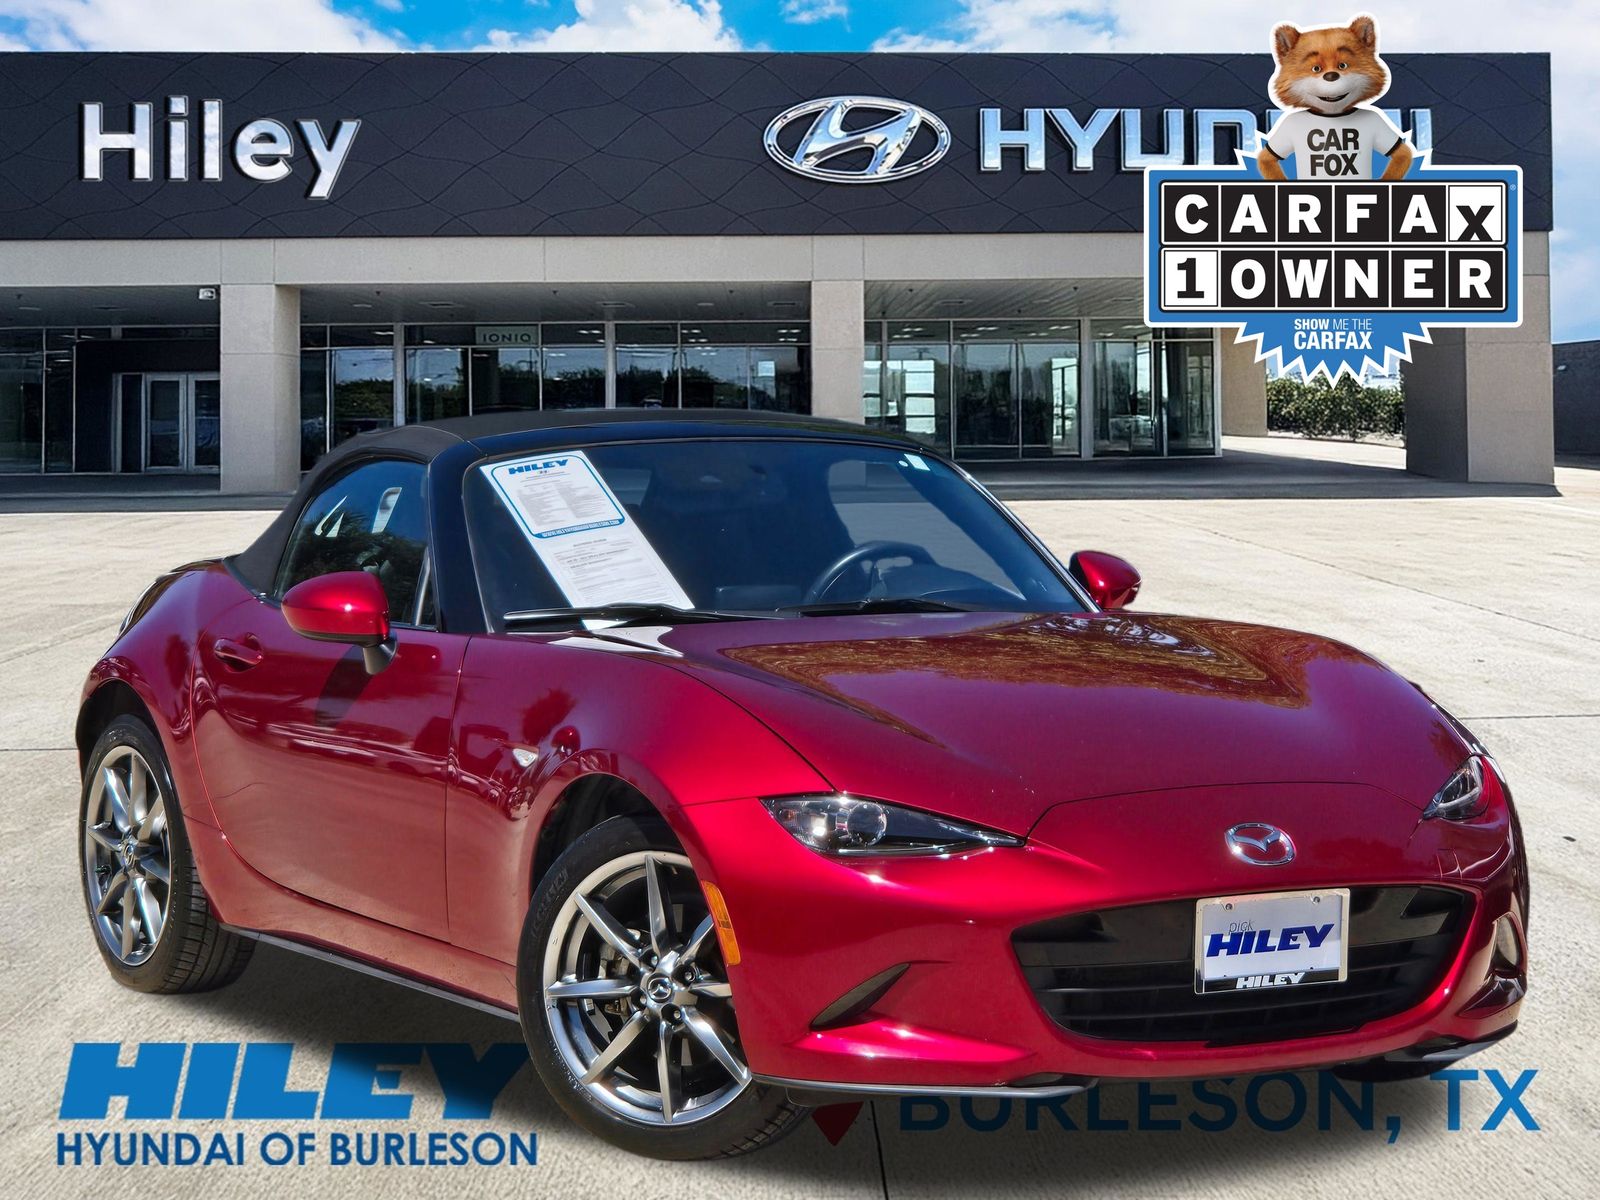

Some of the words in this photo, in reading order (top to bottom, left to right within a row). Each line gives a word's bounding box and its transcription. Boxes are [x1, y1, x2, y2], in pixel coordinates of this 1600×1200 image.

[80, 95, 362, 200] Hiley
[979, 108, 1433, 171] HYUNI
[482, 333, 531, 343] IONIQ
[508, 459, 569, 475] HILEY
[1206, 923, 1335, 957] HILEY
[1236, 972, 1306, 989] HILEY
